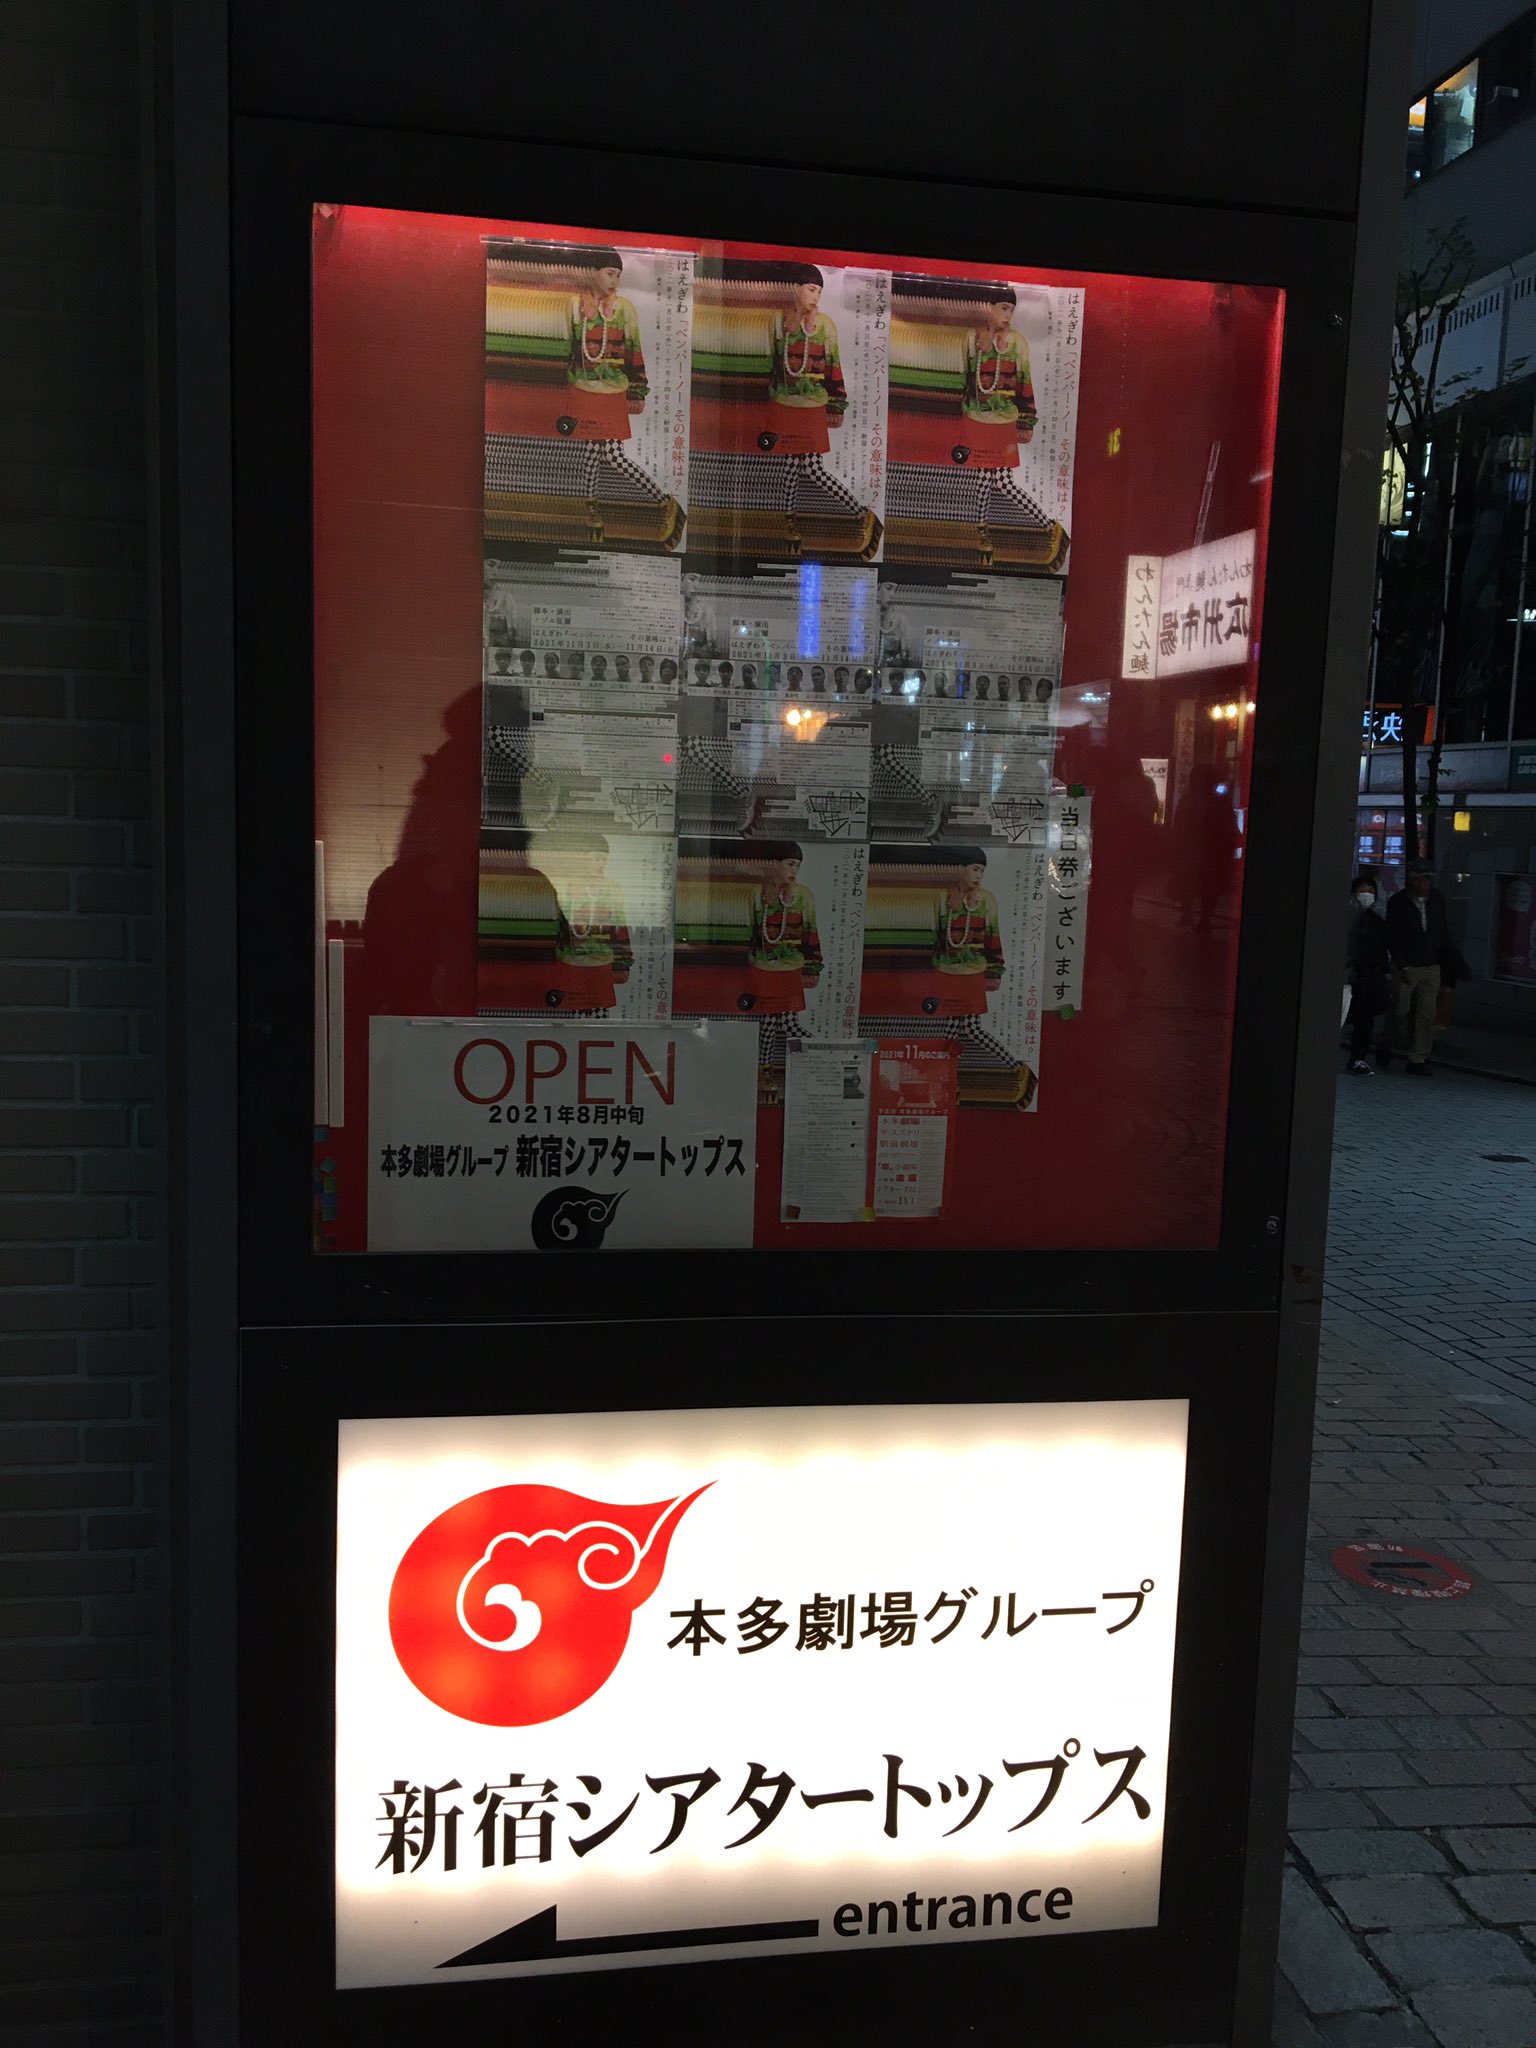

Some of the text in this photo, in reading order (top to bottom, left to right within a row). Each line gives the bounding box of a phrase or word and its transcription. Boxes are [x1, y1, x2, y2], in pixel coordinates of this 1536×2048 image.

[1053, 806, 1079, 1000] 当日券ございます
[453, 1038, 677, 1106] OPEN
[488, 1105, 645, 1125] 2021年8月中旬
[381, 1134, 746, 1178] 本多劇場グループ 新宿シアタートップス
[666, 1577, 1156, 1657] 本多劇場グループ
[375, 1737, 1153, 1875] 新宿シアタートップス
[832, 1885, 1075, 1938] entrance
